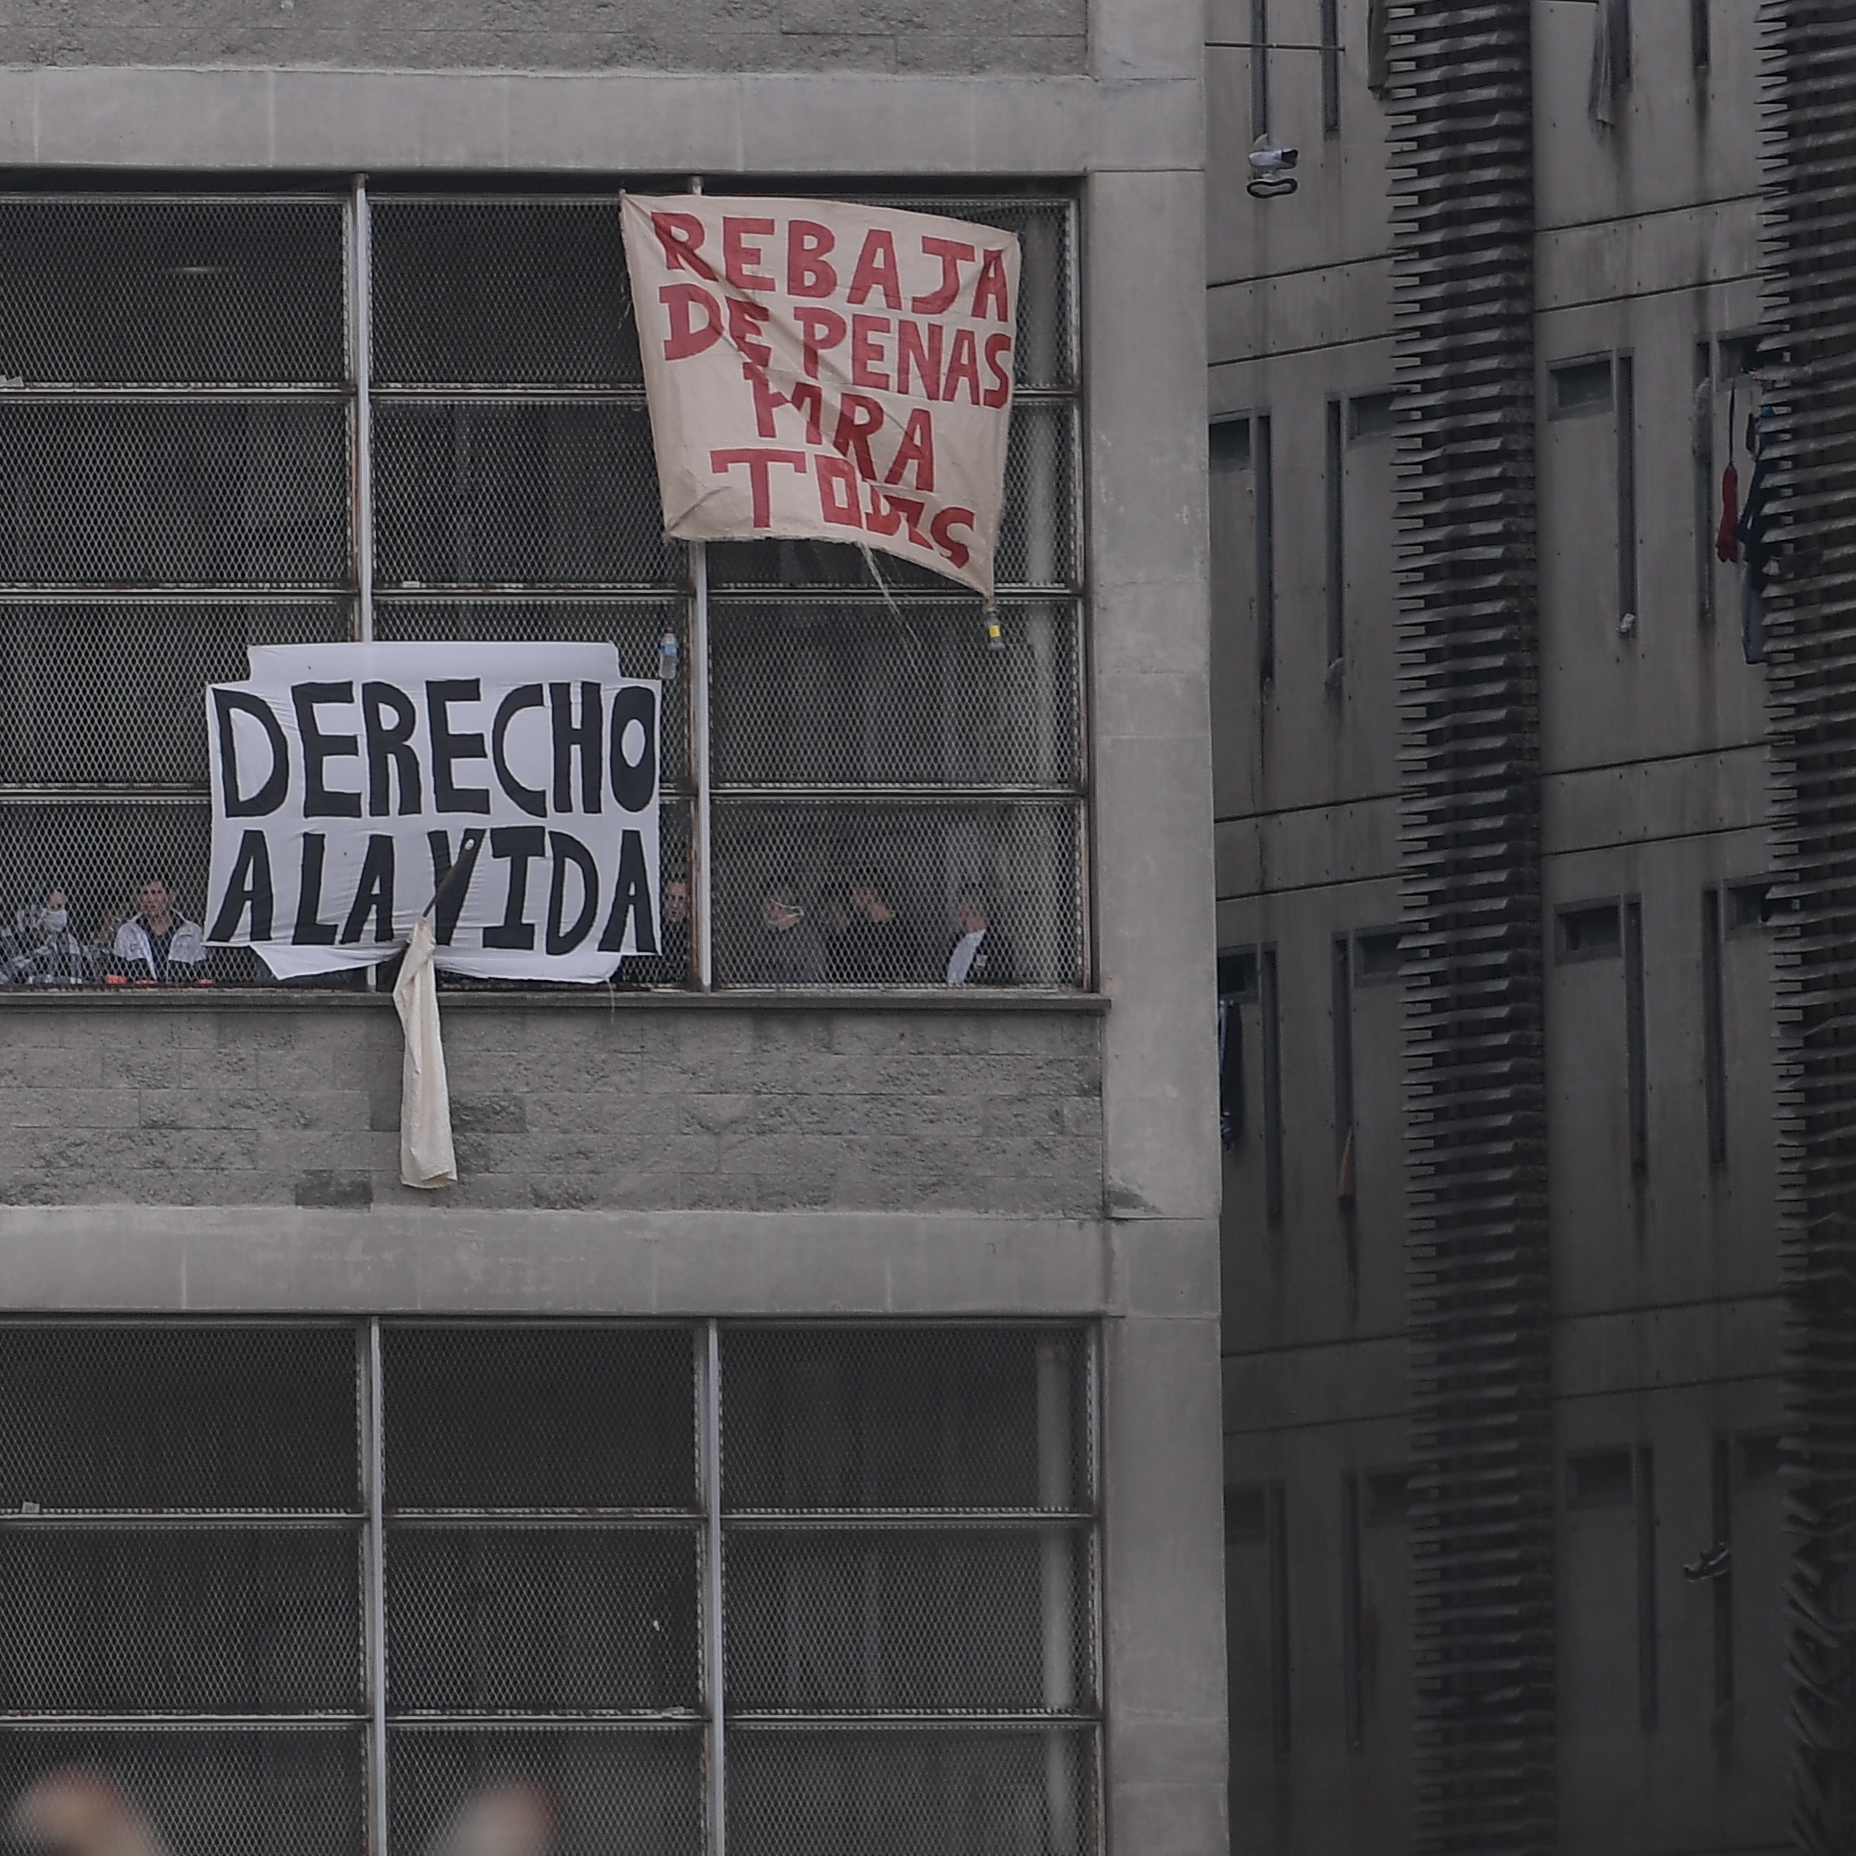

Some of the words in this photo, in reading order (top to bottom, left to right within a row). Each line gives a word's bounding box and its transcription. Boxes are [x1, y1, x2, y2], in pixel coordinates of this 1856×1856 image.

[651, 211, 1009, 323] REBAJA
[658, 283, 772, 368] DE
[793, 305, 1012, 410] PENAS
[211, 678, 656, 818] DERECHO
[206, 829, 273, 942] A
[291, 831, 395, 946] LA
[427, 825, 657, 956] VIDA
